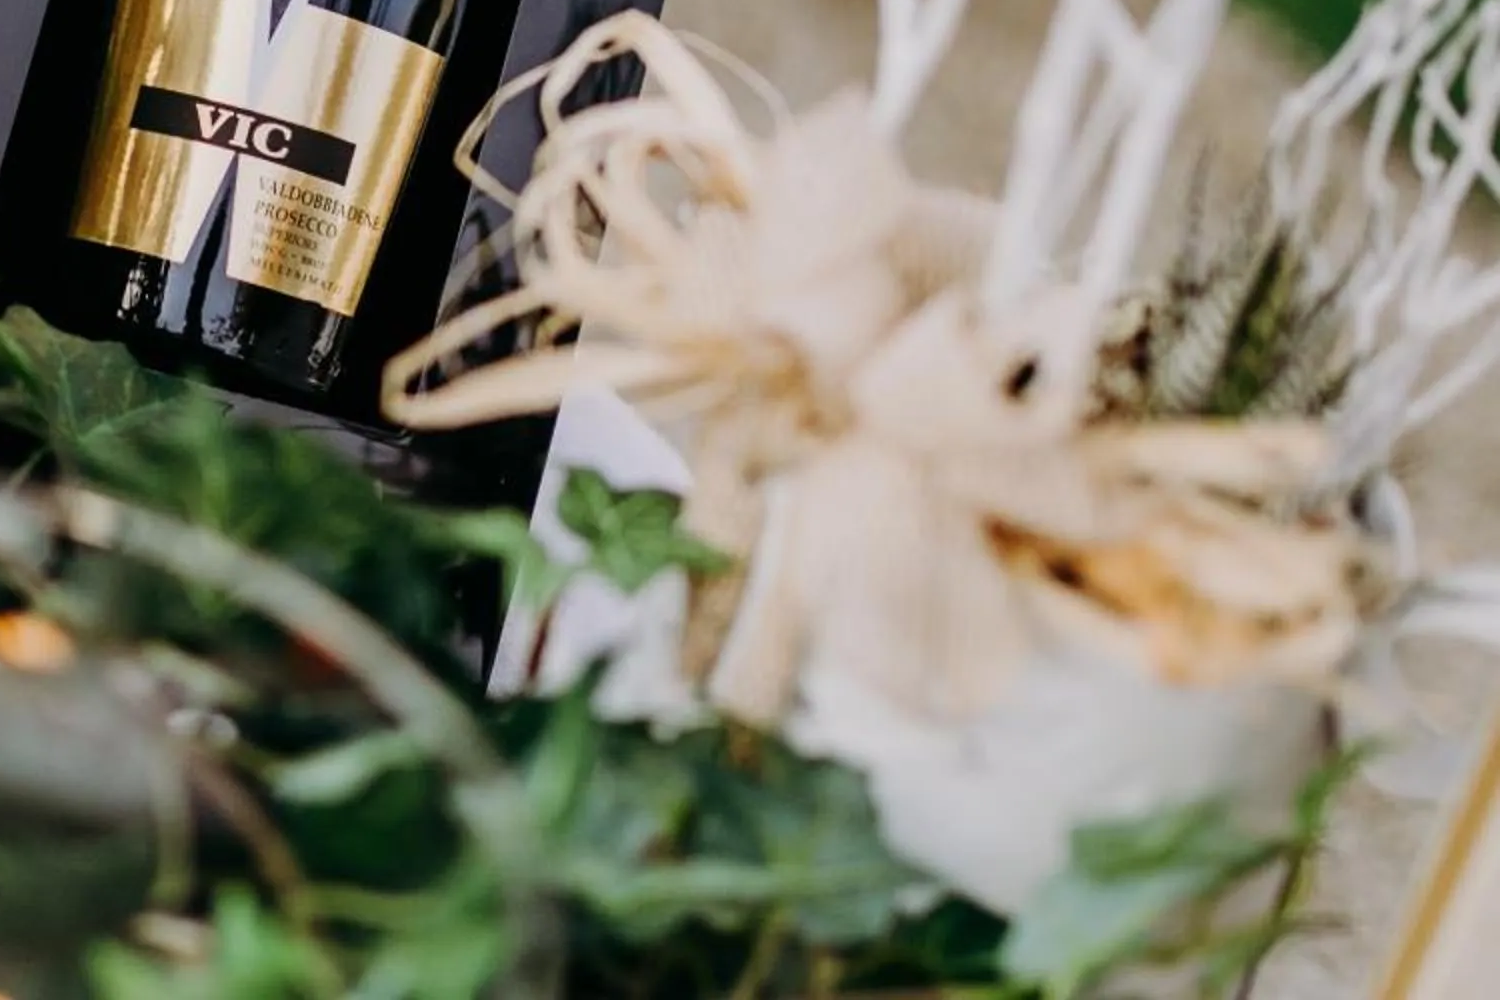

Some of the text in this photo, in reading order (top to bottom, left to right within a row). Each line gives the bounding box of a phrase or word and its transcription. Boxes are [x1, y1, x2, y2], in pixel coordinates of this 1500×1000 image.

[194, 103, 293, 160] VIC
[253, 199, 338, 239] PROSECCO
[258, 175, 380, 231] VALDOBBIADENE
